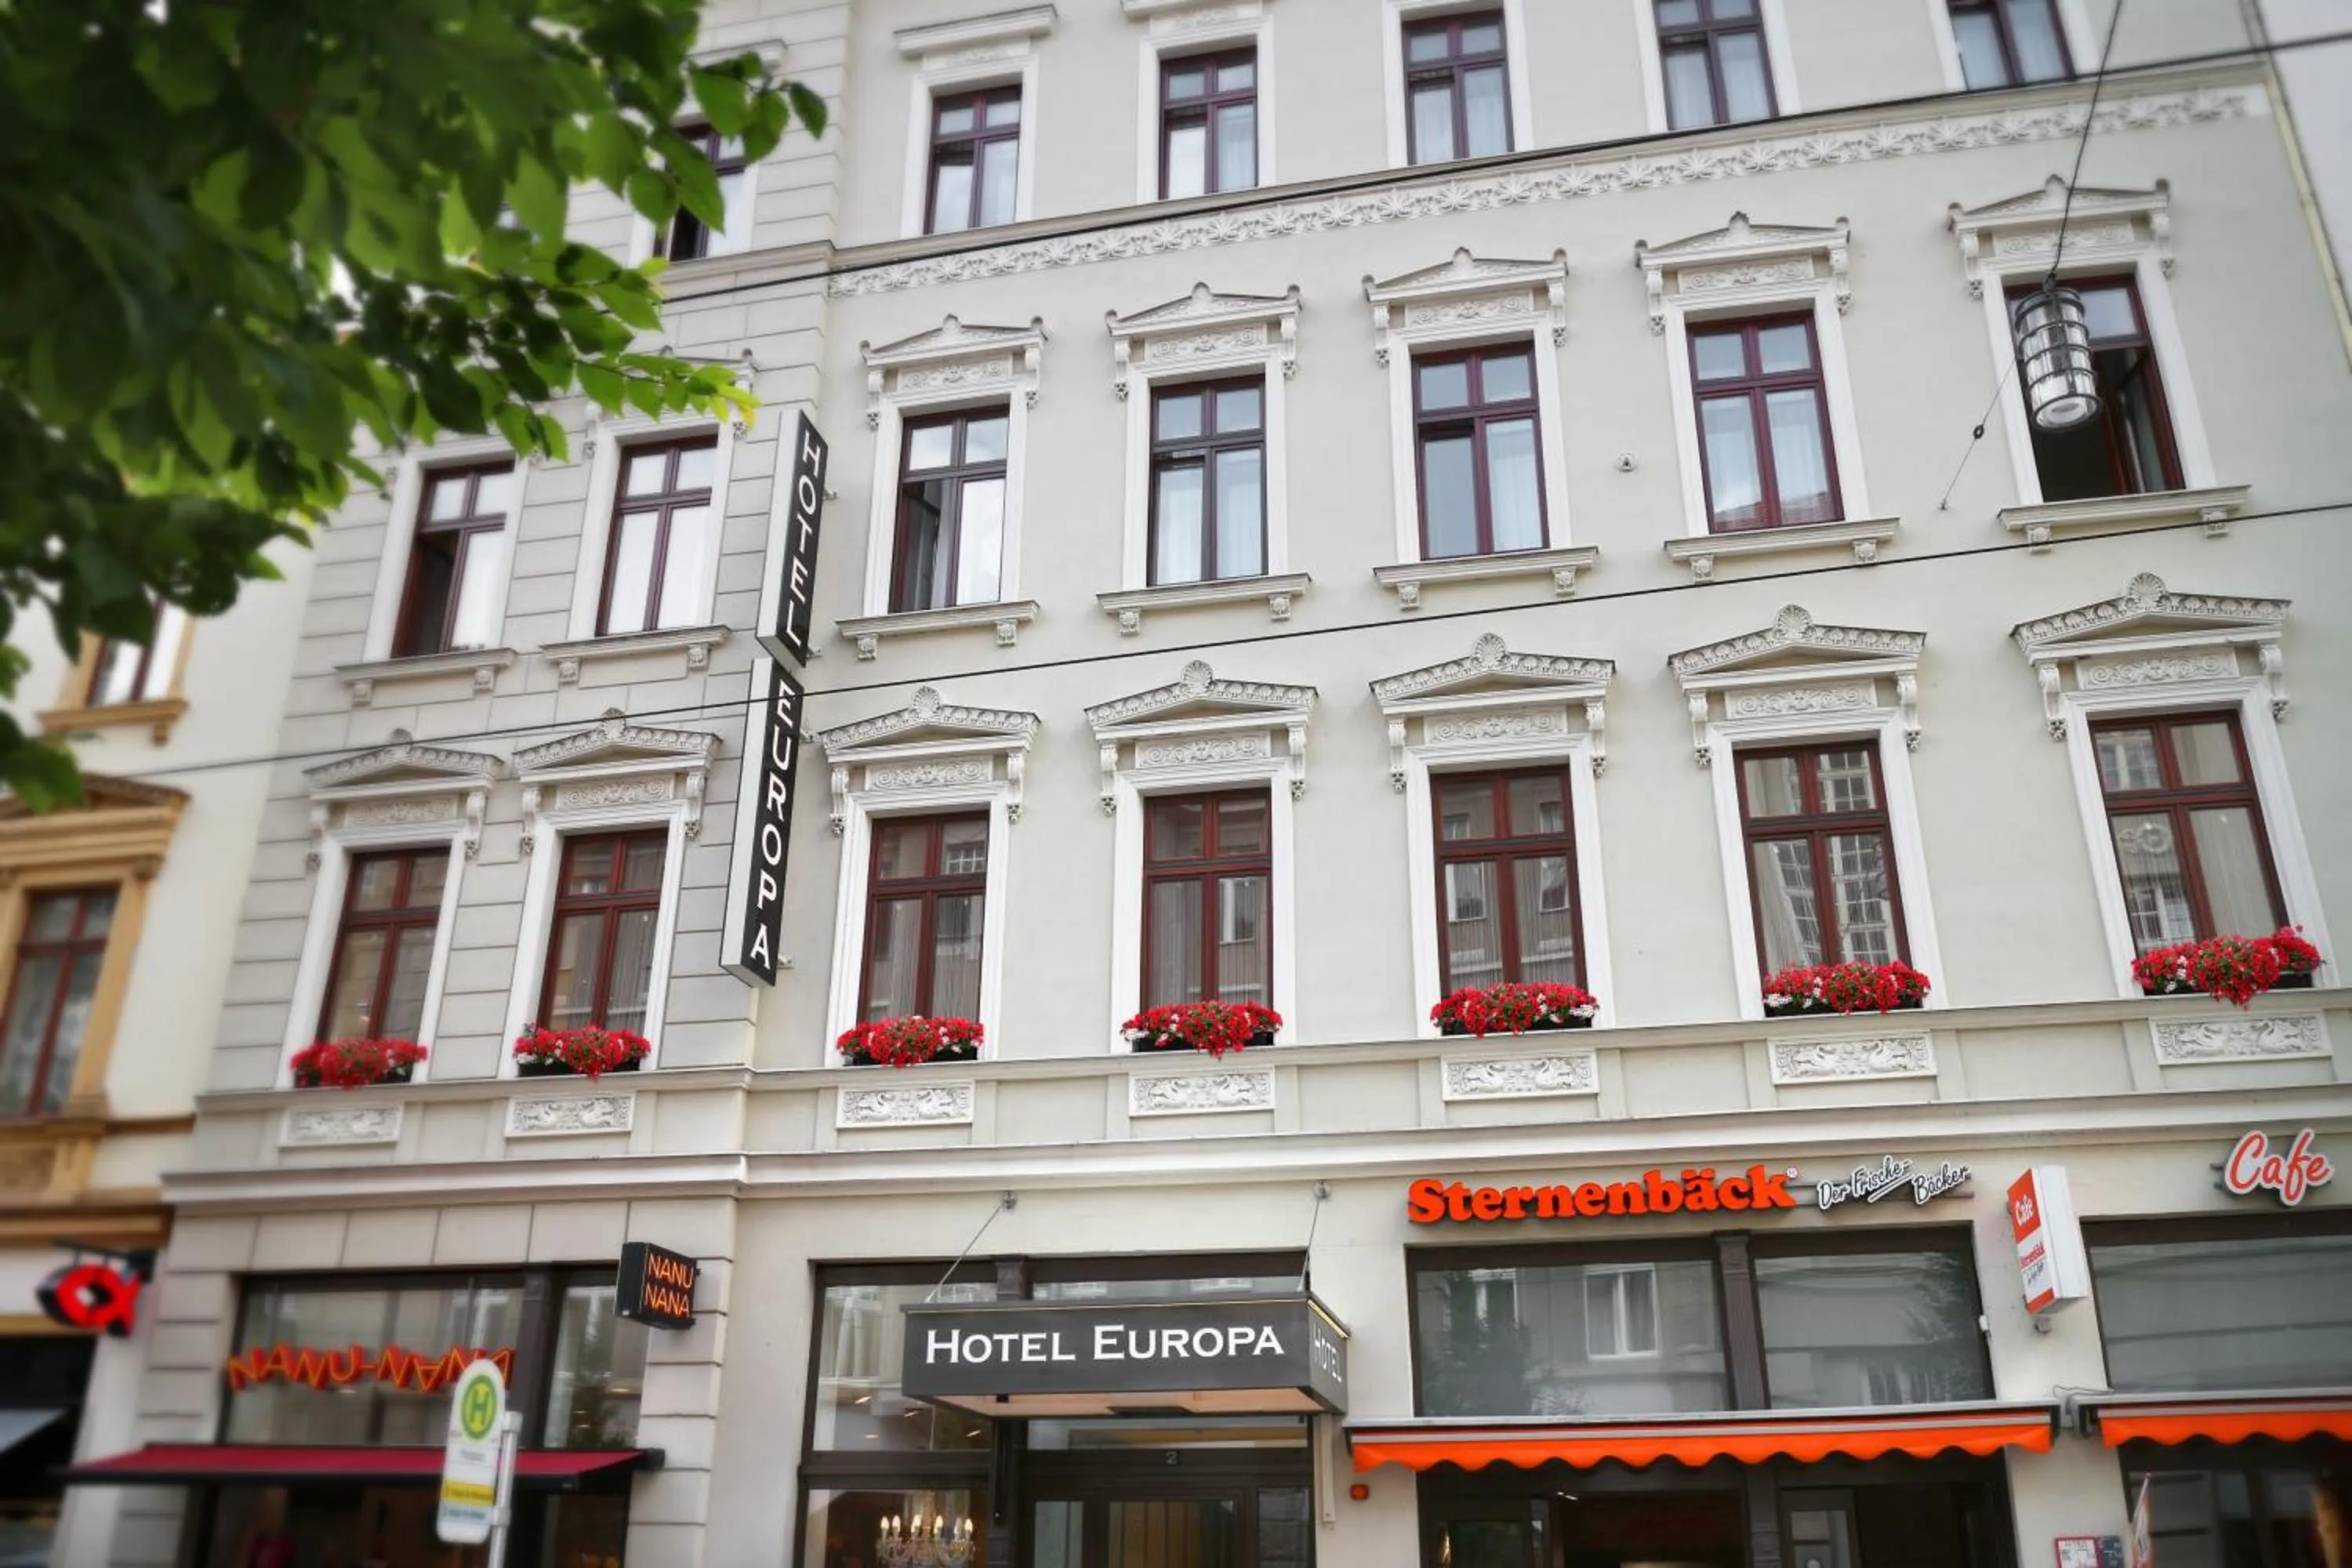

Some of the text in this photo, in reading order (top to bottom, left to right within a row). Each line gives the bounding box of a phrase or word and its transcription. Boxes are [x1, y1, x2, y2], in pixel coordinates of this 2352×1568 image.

[786, 429, 821, 646] HOTEL
[750, 679, 796, 970] EUROPA
[1817, 1180, 1850, 1210] Der
[1911, 1162, 1969, 1206] Bäcker
[2228, 1131, 2332, 1203] Cafe
[1407, 1164, 1796, 1222] Sternenbäck
[648, 1253, 694, 1289] NANU
[644, 1282, 690, 1318] NANA
[926, 1323, 1285, 1364] HOTEL EUROPA
[1312, 1322, 1342, 1384] HOTEL
[470, 1385, 492, 1429] H
[1166, 1451, 1178, 1465] 2
